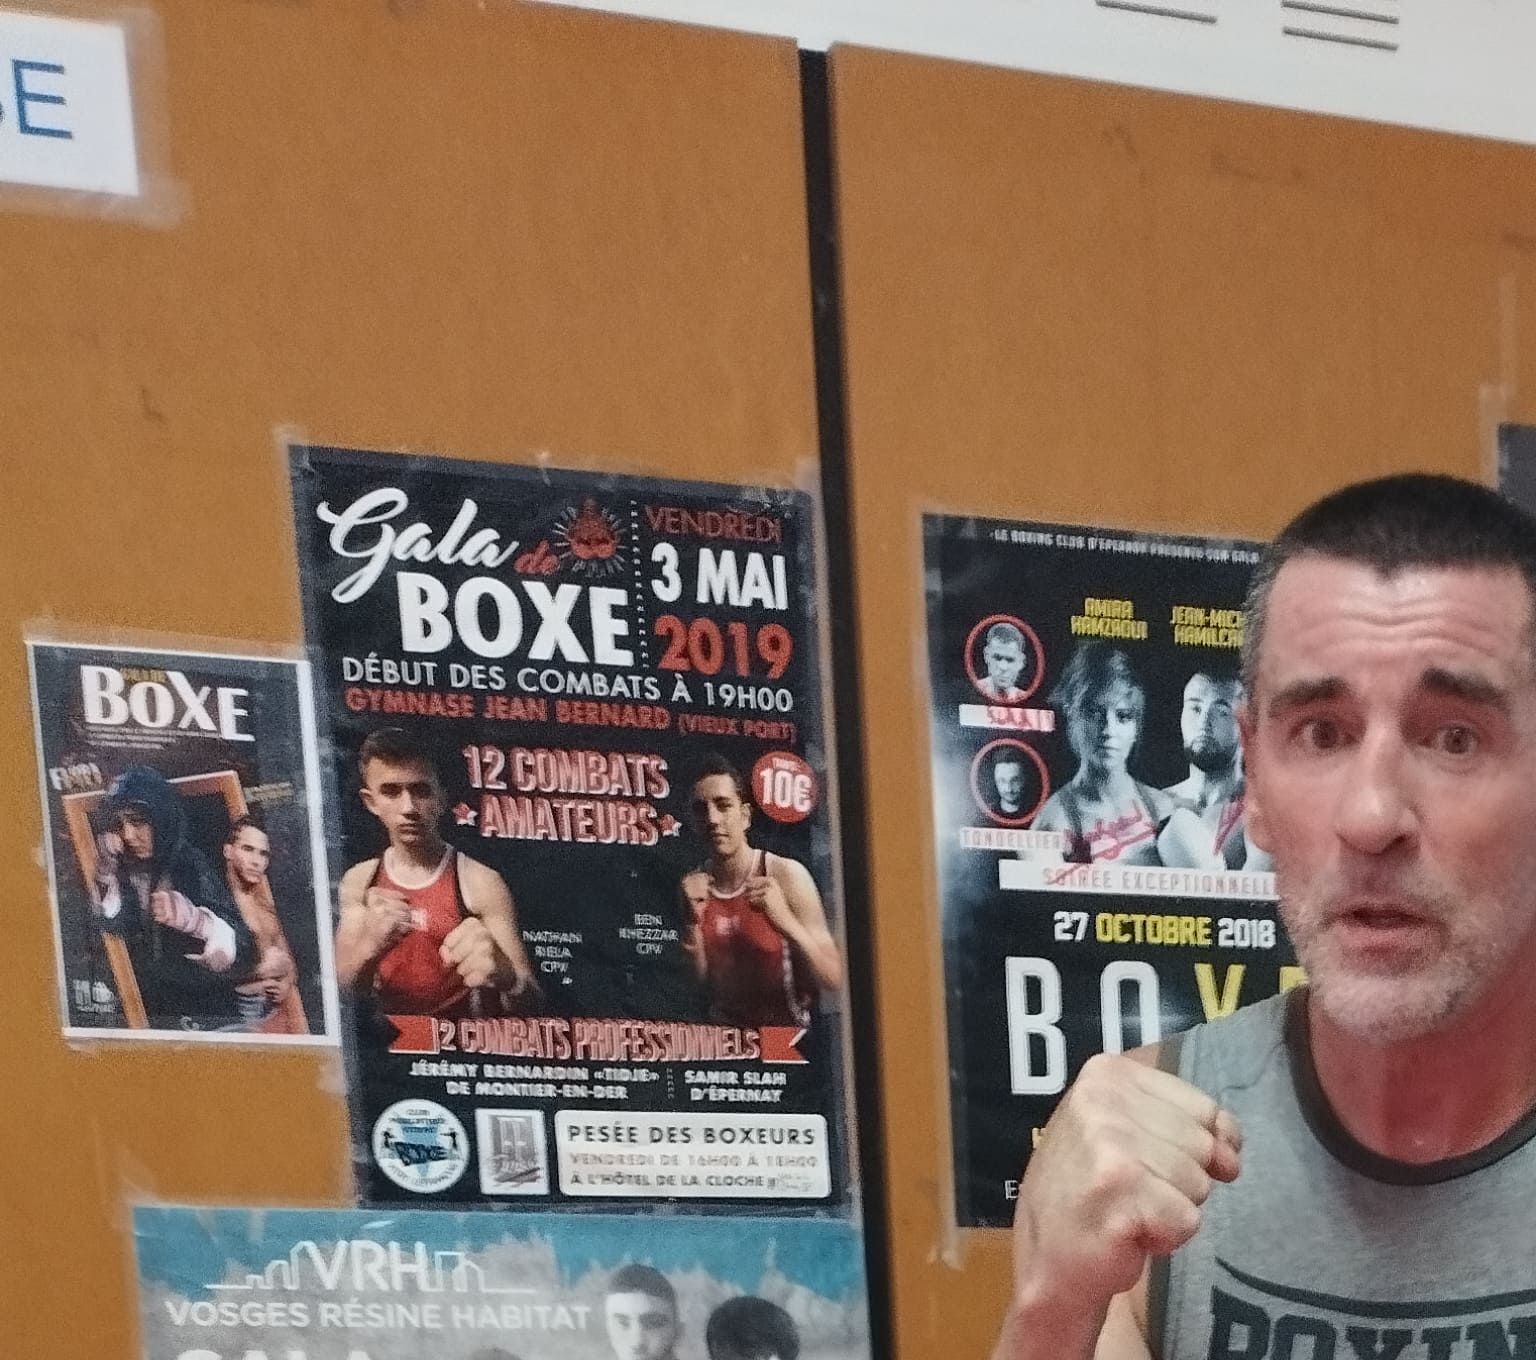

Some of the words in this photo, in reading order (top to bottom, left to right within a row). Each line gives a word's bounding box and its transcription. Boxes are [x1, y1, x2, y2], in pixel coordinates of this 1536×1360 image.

[0, 58, 73, 140] E
[317, 487, 519, 603] Gala
[646, 505, 783, 542] VENDREDI
[651, 542, 682, 602] 3
[699, 548, 789, 610] MAI
[397, 572, 635, 667] BOXE
[653, 615, 793, 680] 2019
[342, 651, 438, 686] DÉBUT
[450, 663, 506, 690] DES
[517, 667, 661, 701] COMBATS
[671, 672, 693, 703] À
[704, 682, 794, 713] 19H00
[344, 687, 474, 718] GYMNASE
[485, 694, 548, 722] JEAN
[555, 699, 671, 730] BERNARD
[462, 743, 507, 791] 12
[510, 747, 671, 799] COMBATS
[759, 767, 812, 814] 10€
[480, 794, 659, 847] AMATEURS
[1122, 870, 1272, 895] EXCEPTIONNELL
[1054, 911, 1090, 942] 27
[1095, 913, 1212, 946] OCTOBRE
[1218, 918, 1276, 948] 2018
[461, 1017, 572, 1060] COMBATS
[574, 1017, 760, 1062] PROFESSIONNELS
[1005, 956, 1309, 1095] BO
[446, 1080, 471, 1096] DE
[475, 1082, 628, 1099] MONTIER-EN-DER
[567, 1121, 639, 1143] PESÉE
[649, 1126, 693, 1144] DES
[703, 1127, 816, 1145] BOXEURS
[569, 1152, 655, 1167] VENDREDI
[660, 1154, 679, 1167] DE
[588, 1170, 650, 1187] L'HÔTEL
[656, 1174, 676, 1187] DE
[681, 1174, 698, 1187] LA
[705, 1174, 764, 1188] CLOCHE
[308, 1240, 427, 1291] VRH
[165, 1302, 310, 1328] VOSGES
[320, 1293, 442, 1329] RÉSINE
[453, 1304, 591, 1330] HABITAT
